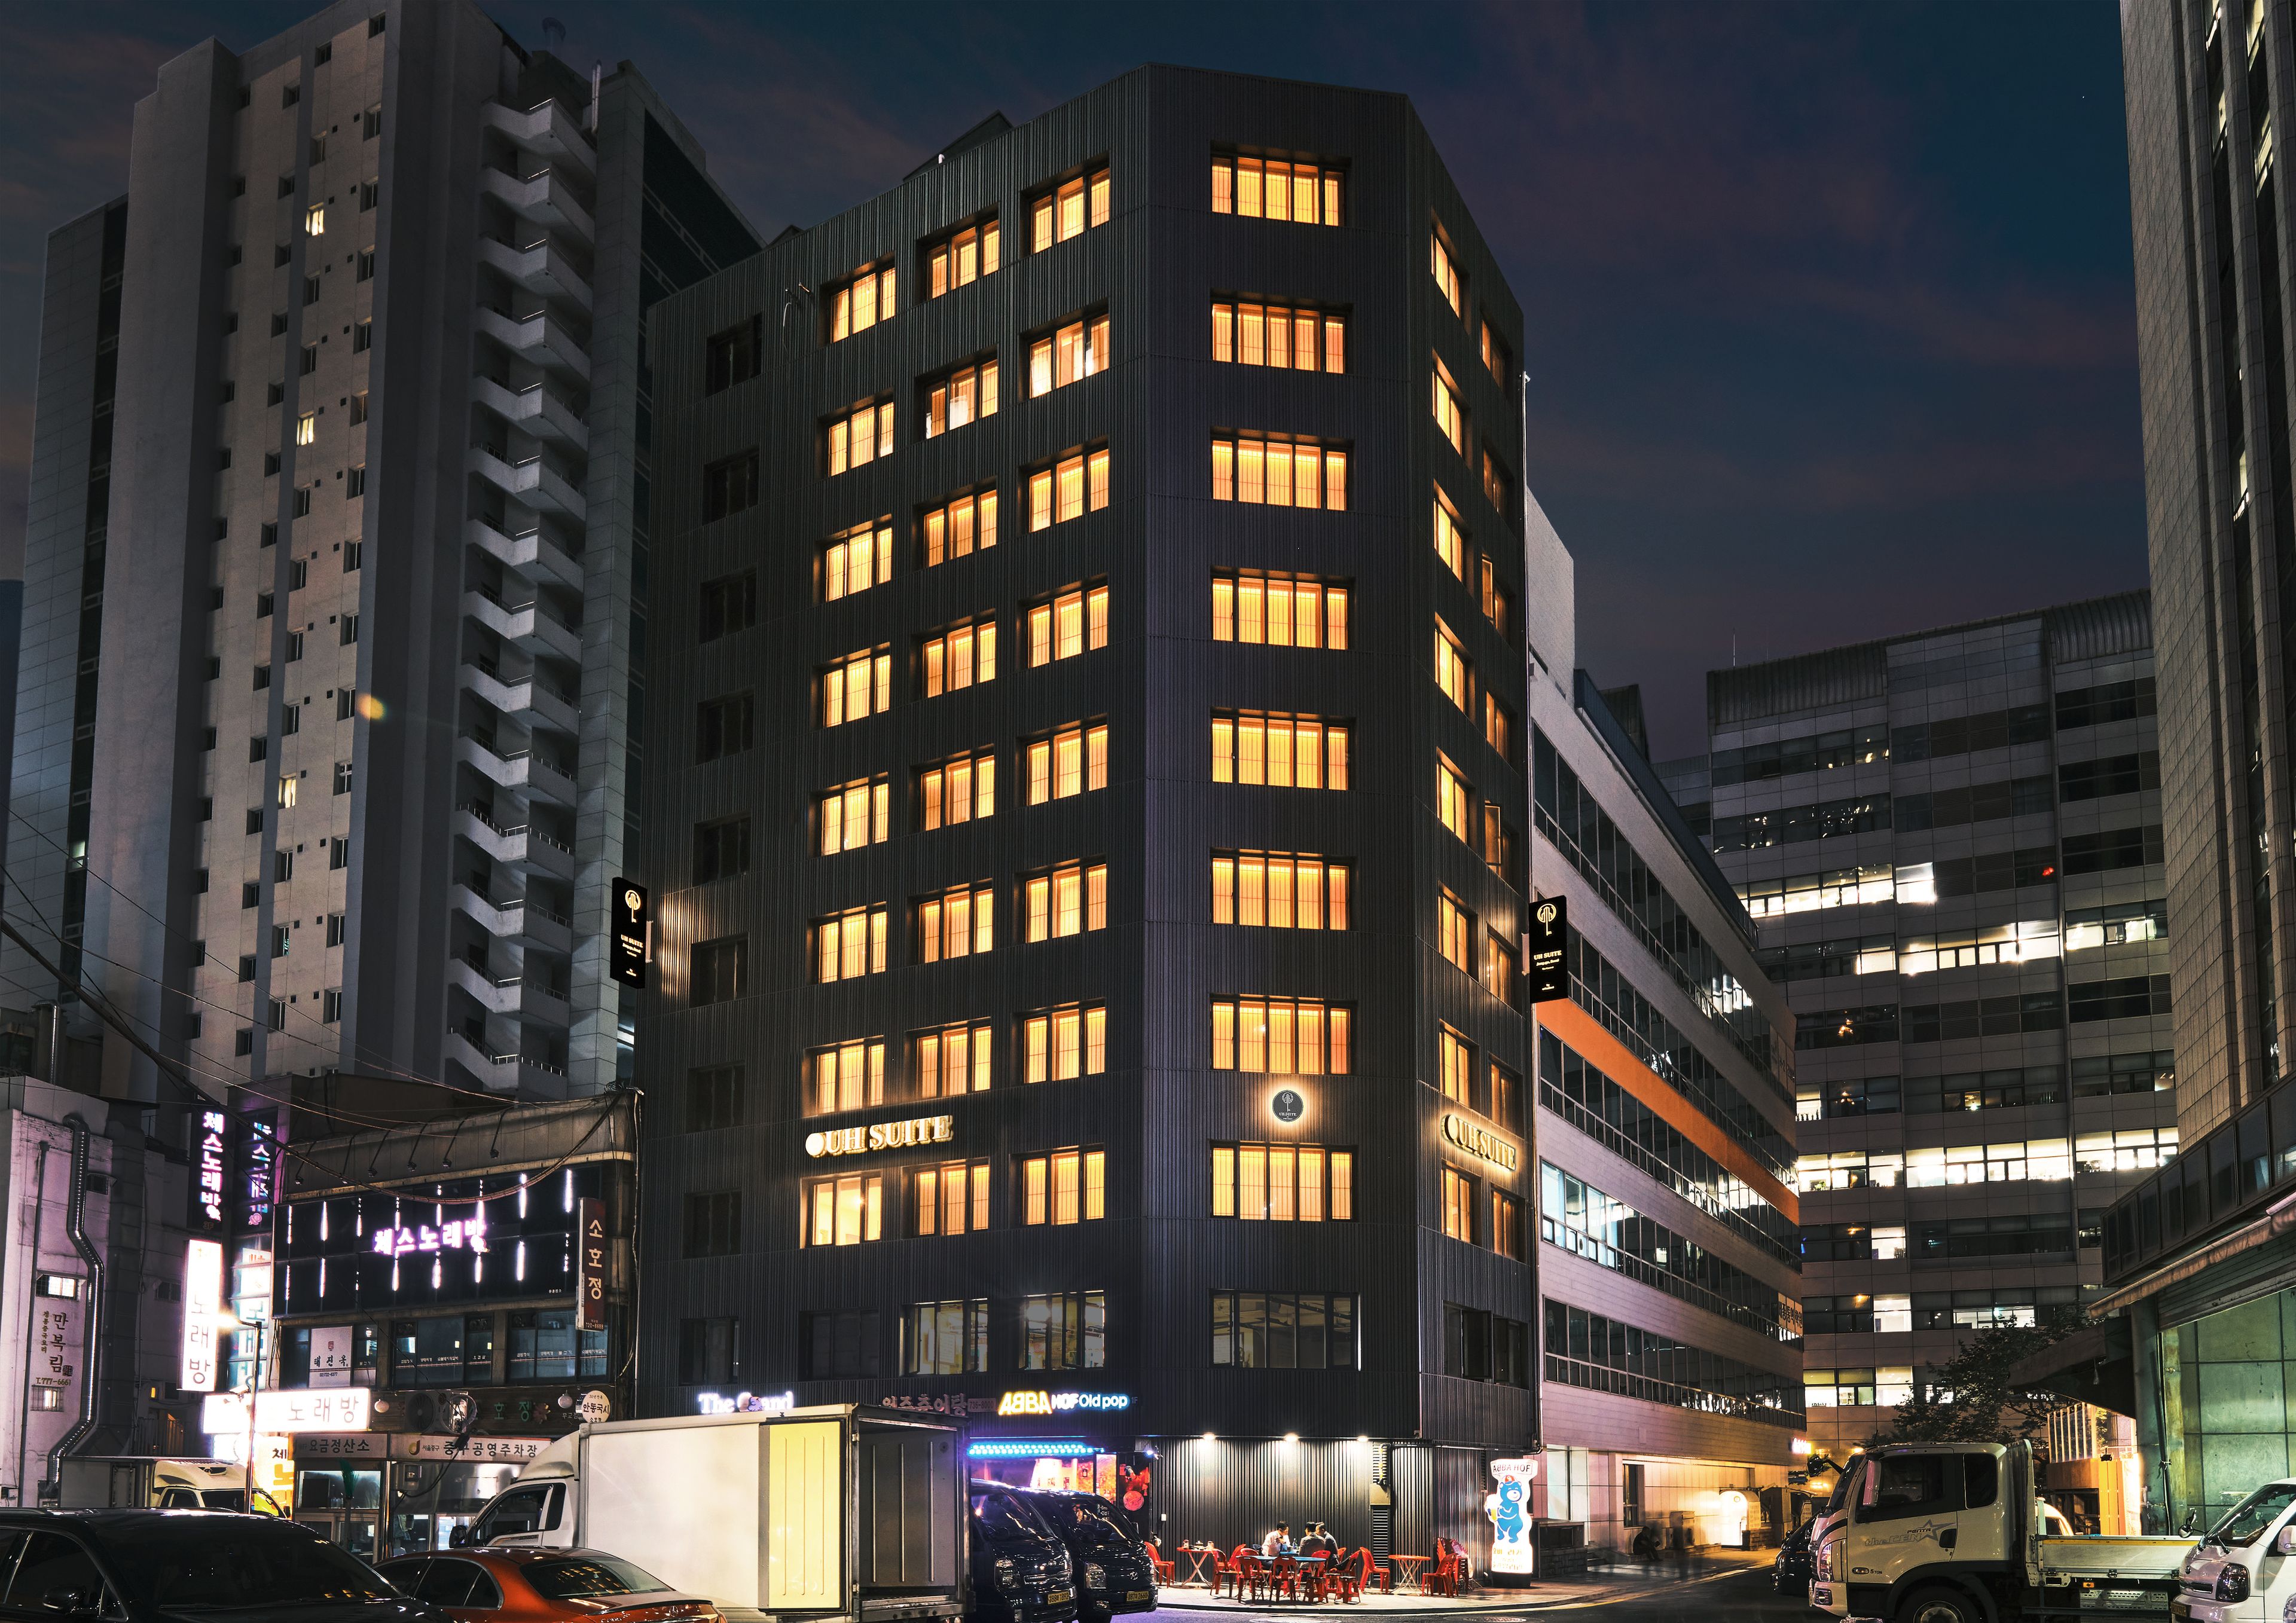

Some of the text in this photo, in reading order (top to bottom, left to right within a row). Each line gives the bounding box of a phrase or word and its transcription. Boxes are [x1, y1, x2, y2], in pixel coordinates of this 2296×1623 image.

[1543, 950, 1562, 958] SUITE
[869, 1115, 953, 1150] SUITE
[1480, 1132, 1515, 1170] SUITE
[200, 1111, 224, 1222] 체스노래방
[373, 1220, 486, 1255] 체스노래방
[588, 1219, 603, 1300] 소호정
[49, 1312, 69, 1373] 만복림
[189, 1294, 211, 1384] 노래방
[288, 1398, 359, 1423] 노래방
[583, 1402, 609, 1414] 안동국시
[698, 1390, 794, 1414] The and
[998, 1391, 1053, 1416] ABBA
[1051, 1393, 1079, 1410] HOF
[1079, 1393, 1101, 1407] Old
[1102, 1396, 1128, 1410] pop
[309, 1438, 370, 1454] 요금정산소
[1514, 1464, 1531, 1472] HOF
